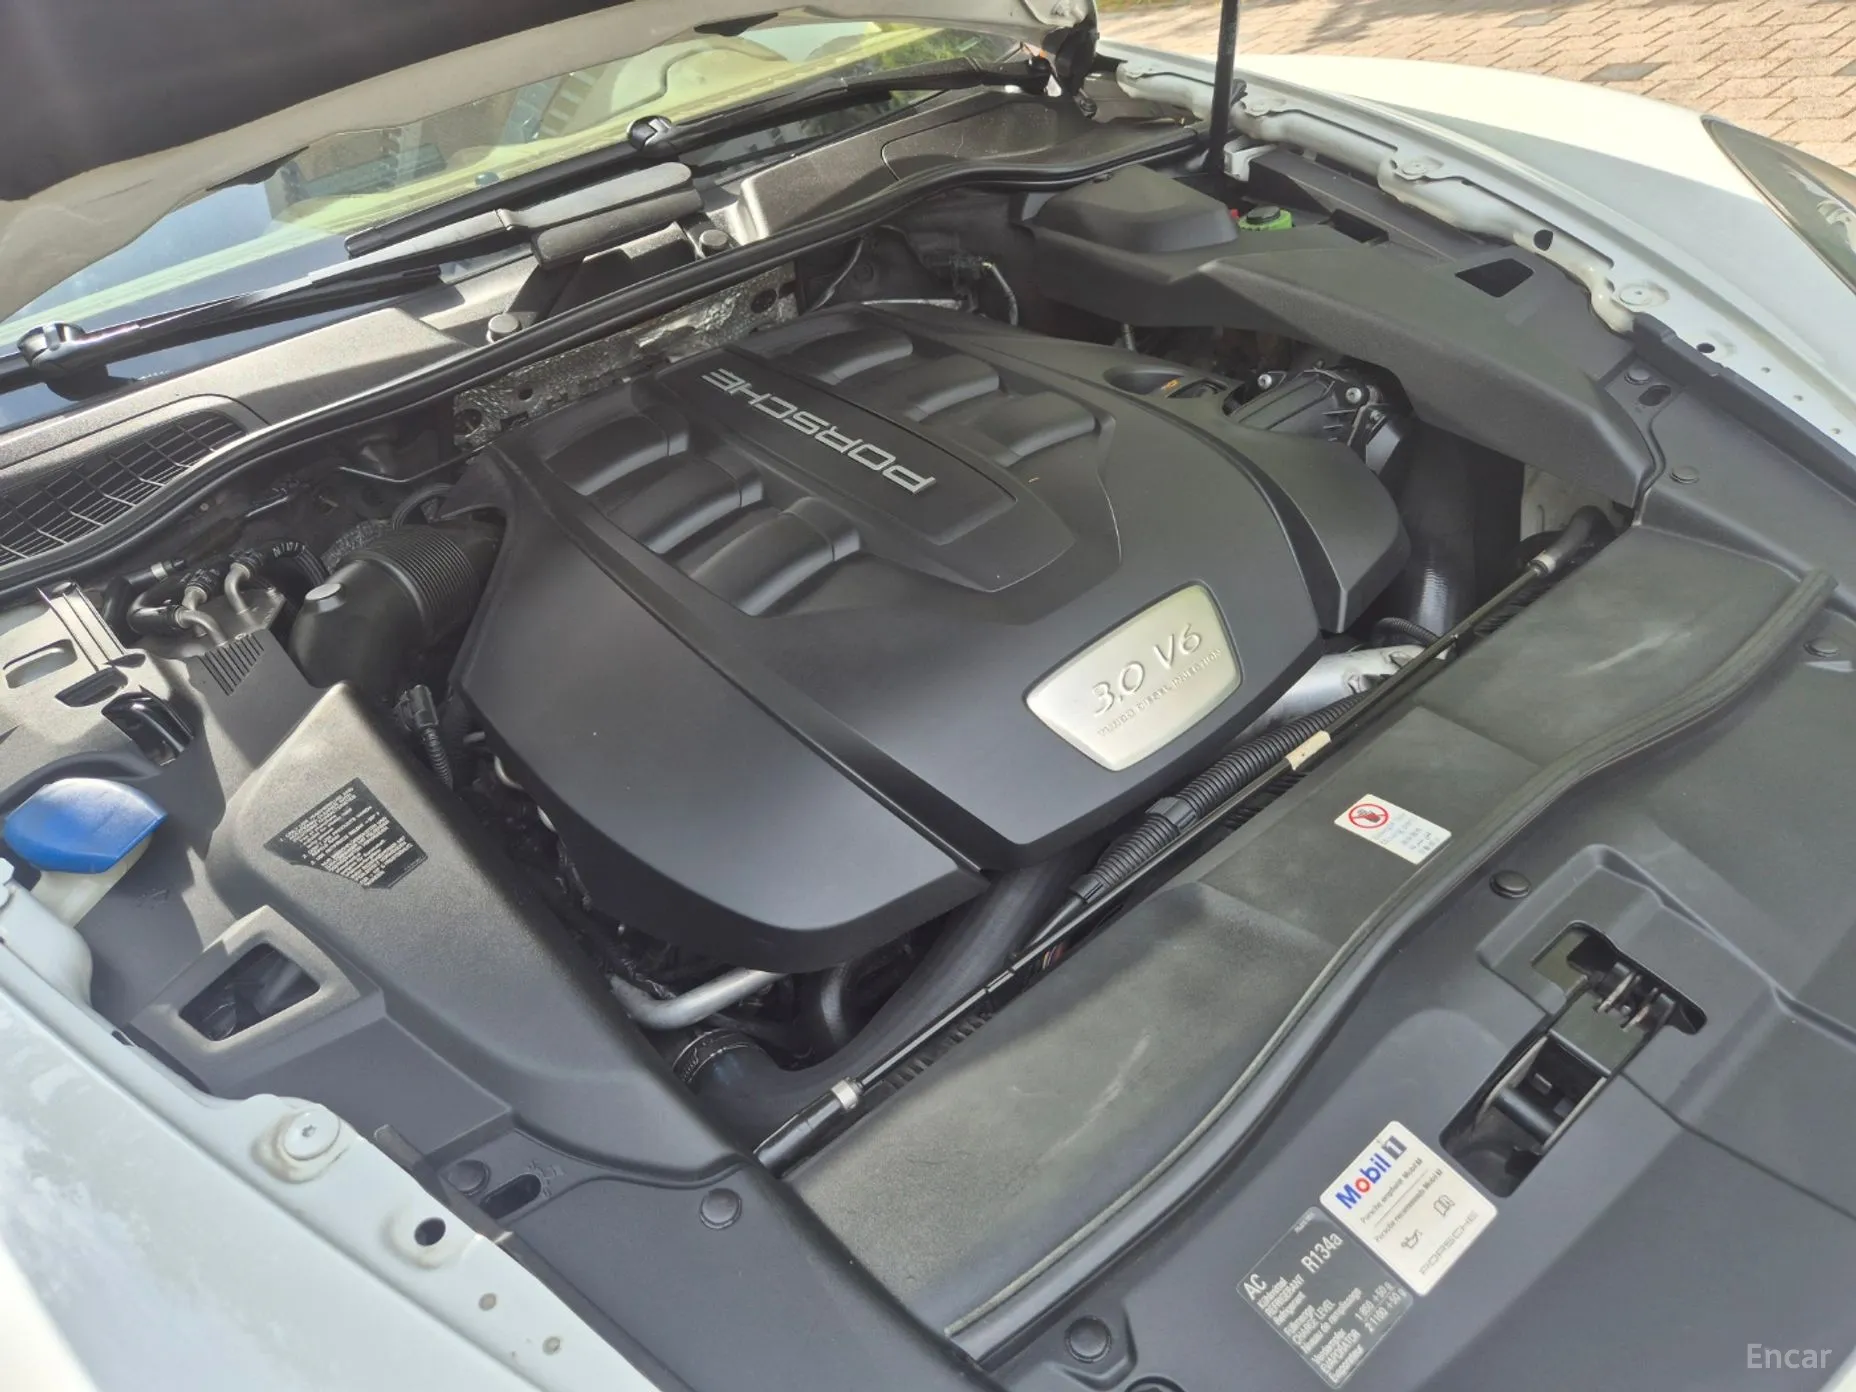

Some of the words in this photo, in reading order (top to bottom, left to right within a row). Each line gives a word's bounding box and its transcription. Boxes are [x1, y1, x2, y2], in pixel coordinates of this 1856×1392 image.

[701, 367, 937, 494] PORSCHE
[1153, 622, 1202, 670] V6
[1336, 1153, 1392, 1209] Mobil
[1382, 1136, 1407, 1161] 1
[1301, 1232, 1344, 1274] R134a
[1419, 1211, 1479, 1276] PORSCHE
[1244, 1274, 1267, 1301] AC
